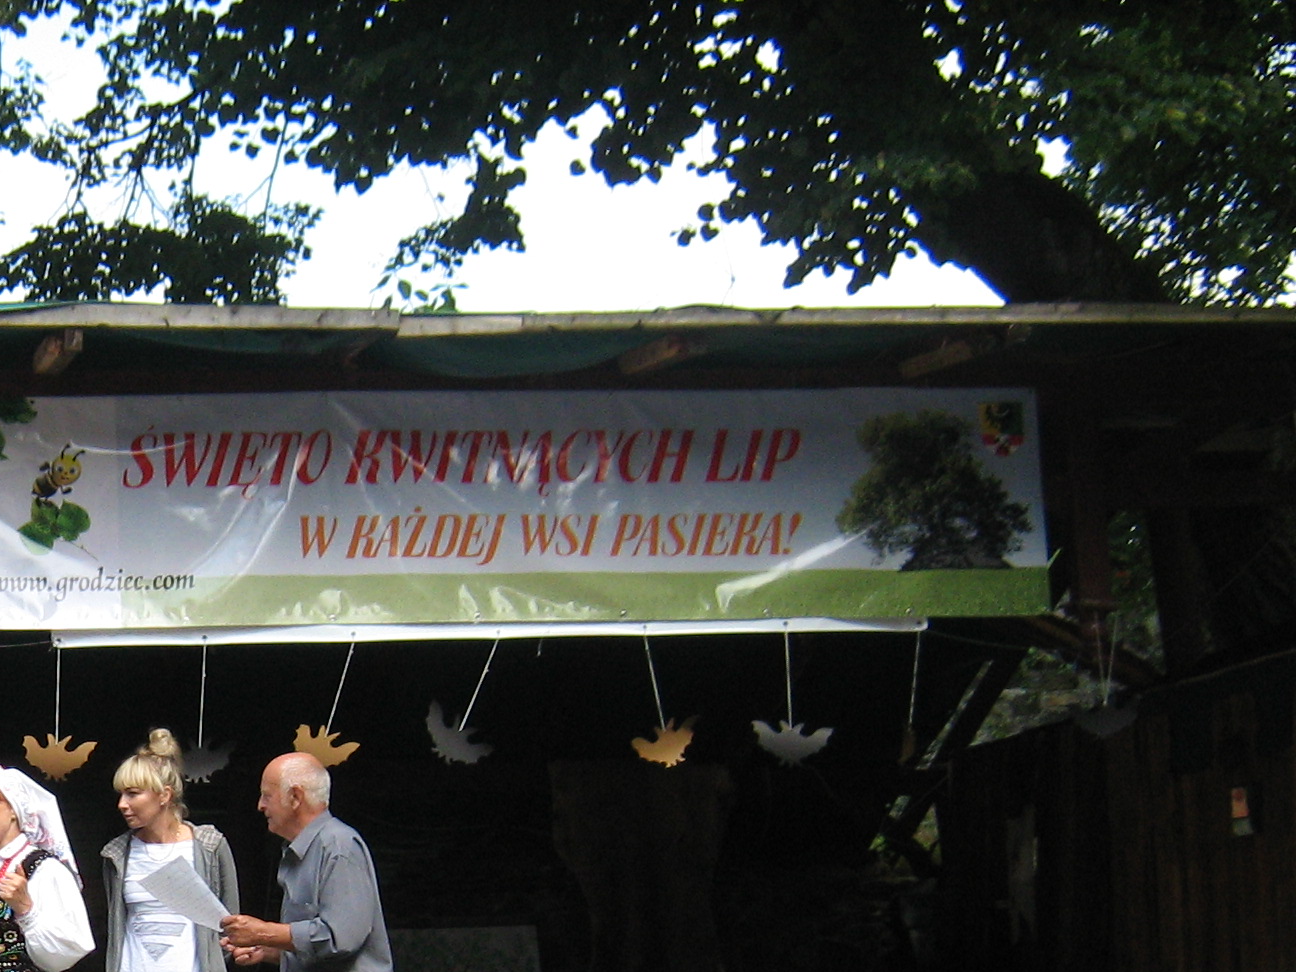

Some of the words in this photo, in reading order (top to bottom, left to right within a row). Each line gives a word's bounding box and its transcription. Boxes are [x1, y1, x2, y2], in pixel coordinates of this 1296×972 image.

[122, 425, 332, 500] ŚWIĘTO
[345, 428, 695, 497] KWITNĄCYCH
[705, 428, 802, 483] LIP
[300, 515, 337, 559] W
[345, 506, 507, 566] KAŻDEJ
[521, 513, 600, 557] WSI
[610, 512, 803, 557] PASIEKA!
